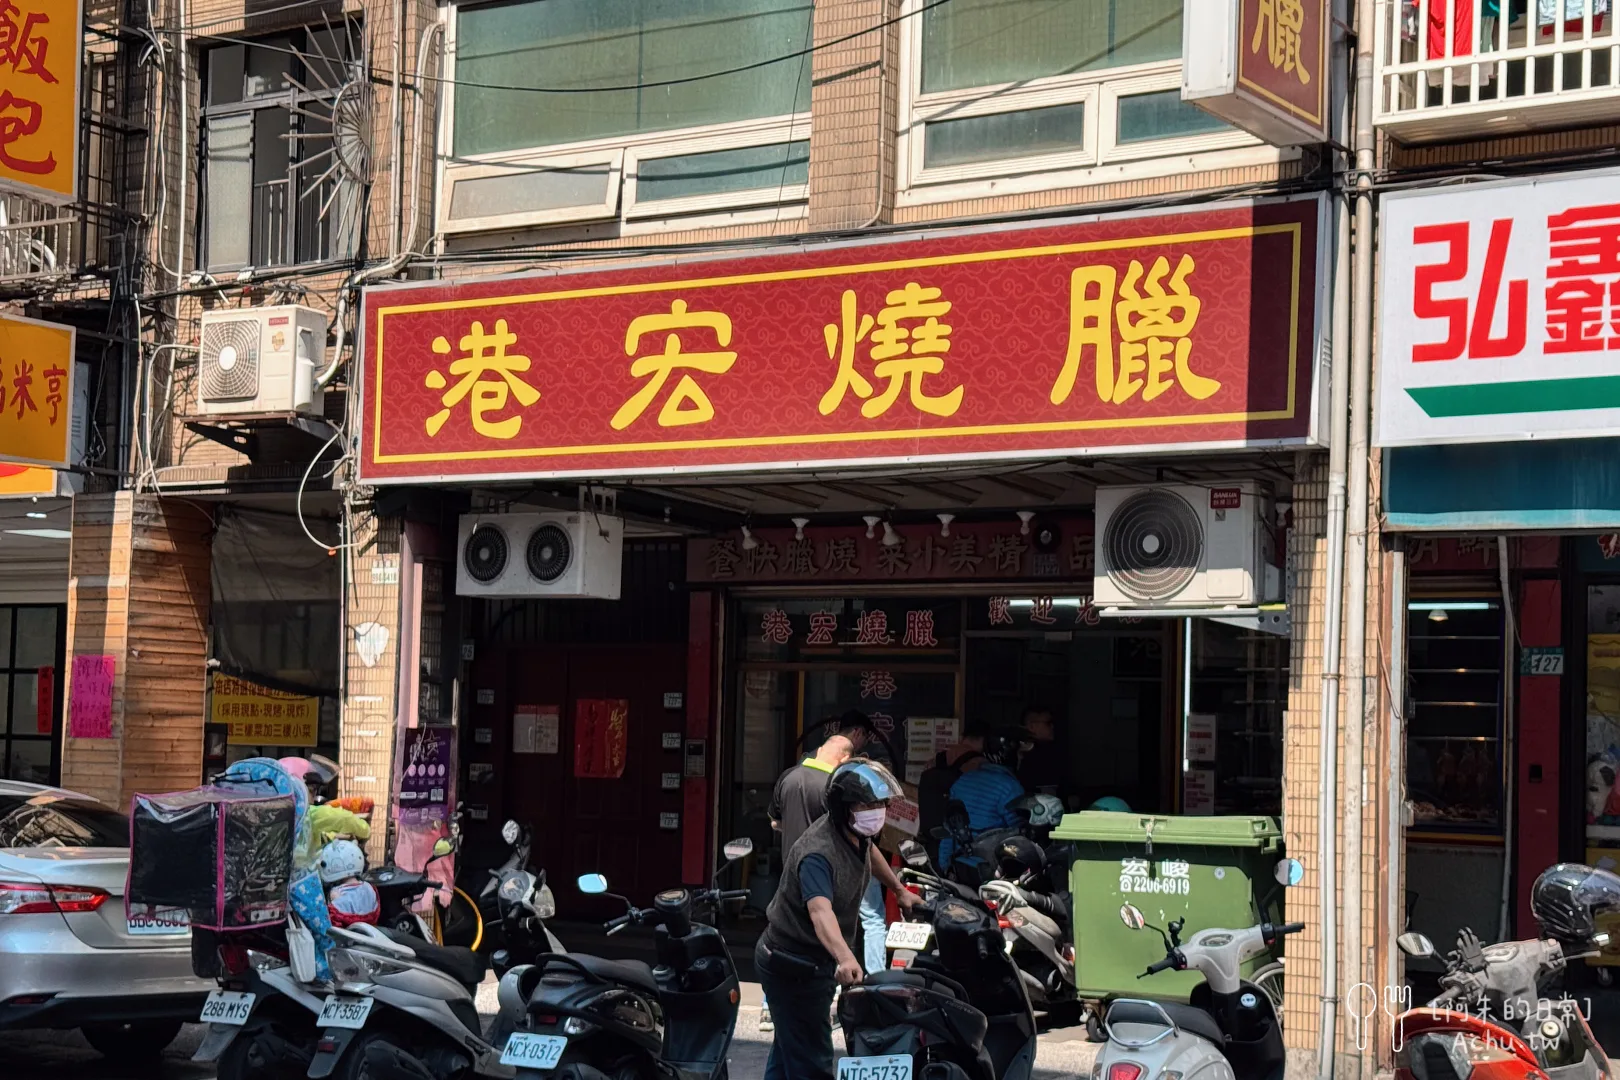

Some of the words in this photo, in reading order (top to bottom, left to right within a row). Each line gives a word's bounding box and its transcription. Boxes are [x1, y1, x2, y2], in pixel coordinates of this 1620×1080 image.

[1411, 203, 1620, 363] 弘鑫
[423, 255, 1222, 440] 港宏燒臘
[0, 356, 67, 426] 米亨
[988, 595, 1144, 626] 歡迎光
[761, 609, 939, 647] 港宏燒臘
[1121, 856, 1190, 879] 宏峻
[1133, 876, 1190, 896] 2206-6919
[504, 1040, 562, 1061] NCX-0312
